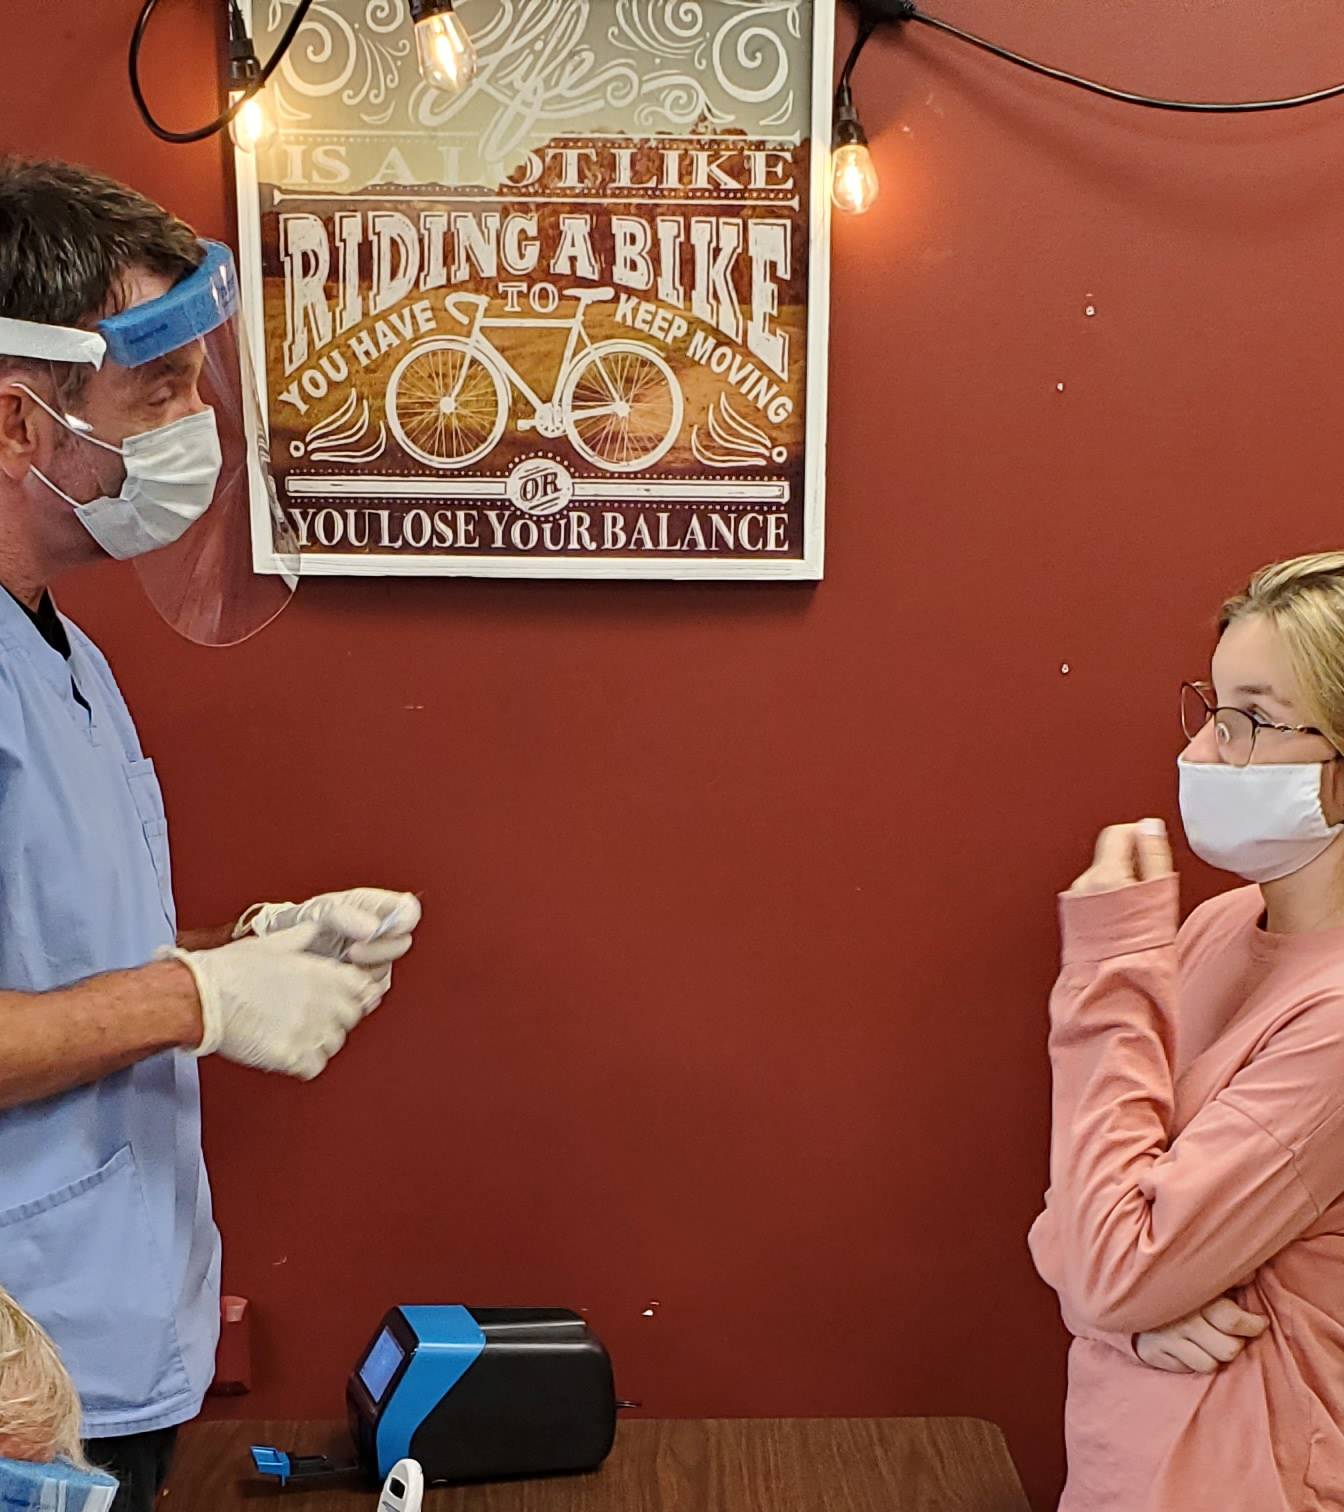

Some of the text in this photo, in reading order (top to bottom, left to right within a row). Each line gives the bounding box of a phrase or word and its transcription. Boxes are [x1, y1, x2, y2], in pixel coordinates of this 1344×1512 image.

[418, 0, 639, 163] Life
[282, 144, 795, 190] IS A LOT LIKE
[278, 211, 792, 383] RIDING A BIKE
[277, 282, 794, 424] YOU HAVE TO KEEP MOVING
[288, 508, 790, 551] YOU LOSE YOUR BALANCE
[520, 472, 562, 500] OR
